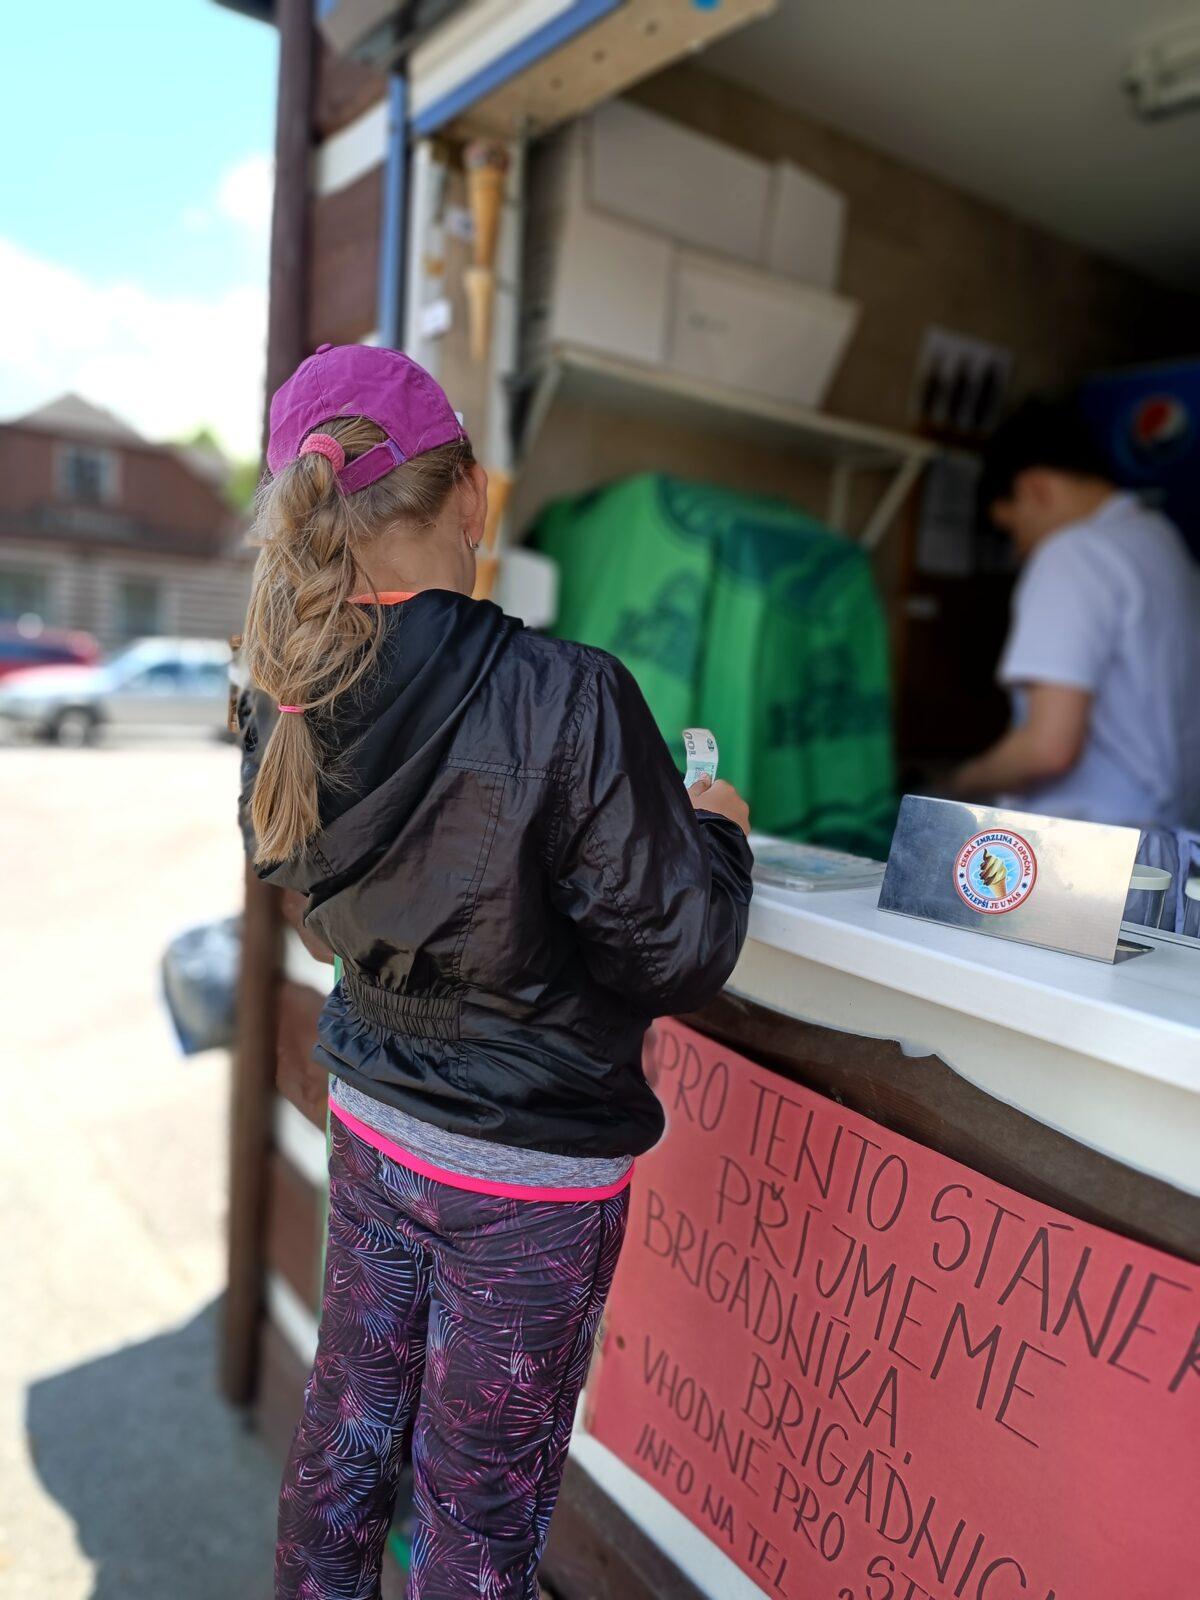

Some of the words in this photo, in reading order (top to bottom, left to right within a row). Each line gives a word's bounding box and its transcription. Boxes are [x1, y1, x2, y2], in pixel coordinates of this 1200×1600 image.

[961, 883, 989, 908] NEJLEPŠÍ
[975, 834, 1013, 847] ZMRZLINA
[1017, 846, 1031, 877] OPOČNA
[656, 1030, 729, 1132] PRO
[749, 1079, 909, 1232] TENTO
[715, 1155, 1067, 1449] PŘÍJMEME
[635, 1423, 694, 1495] INFO
[701, 1484, 735, 1545] NA
[747, 1521, 788, 1598] TEL
[644, 1335, 772, 1497] VHODNÉ
[773, 1462, 846, 1562] PRO
[741, 1352, 1056, 1600] BRIGÁDNIC
